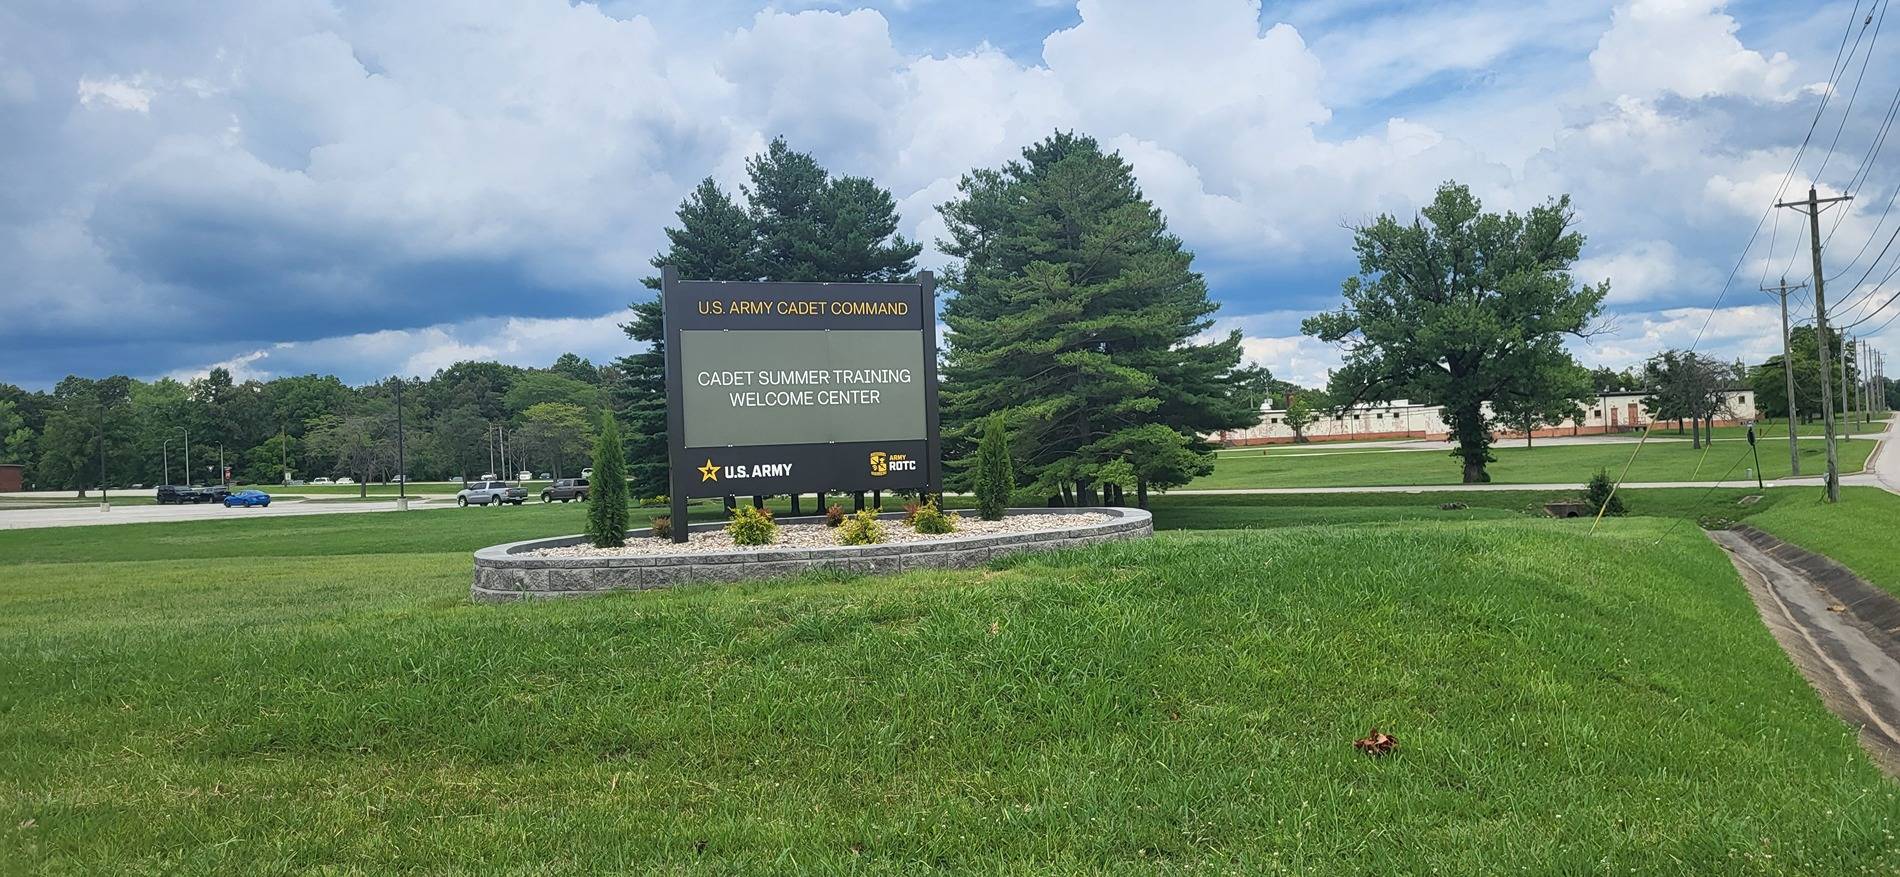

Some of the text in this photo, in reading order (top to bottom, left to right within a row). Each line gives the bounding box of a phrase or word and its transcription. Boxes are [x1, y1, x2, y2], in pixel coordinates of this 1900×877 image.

[698, 301, 908, 315] U.S. ARMY CADET COMMAND
[698, 369, 911, 386] CADET SUMMER TRAINING
[730, 390, 880, 407] WELCOME CENTER
[724, 463, 793, 479] U.S. ARMY
[889, 460, 916, 471] ROTC
